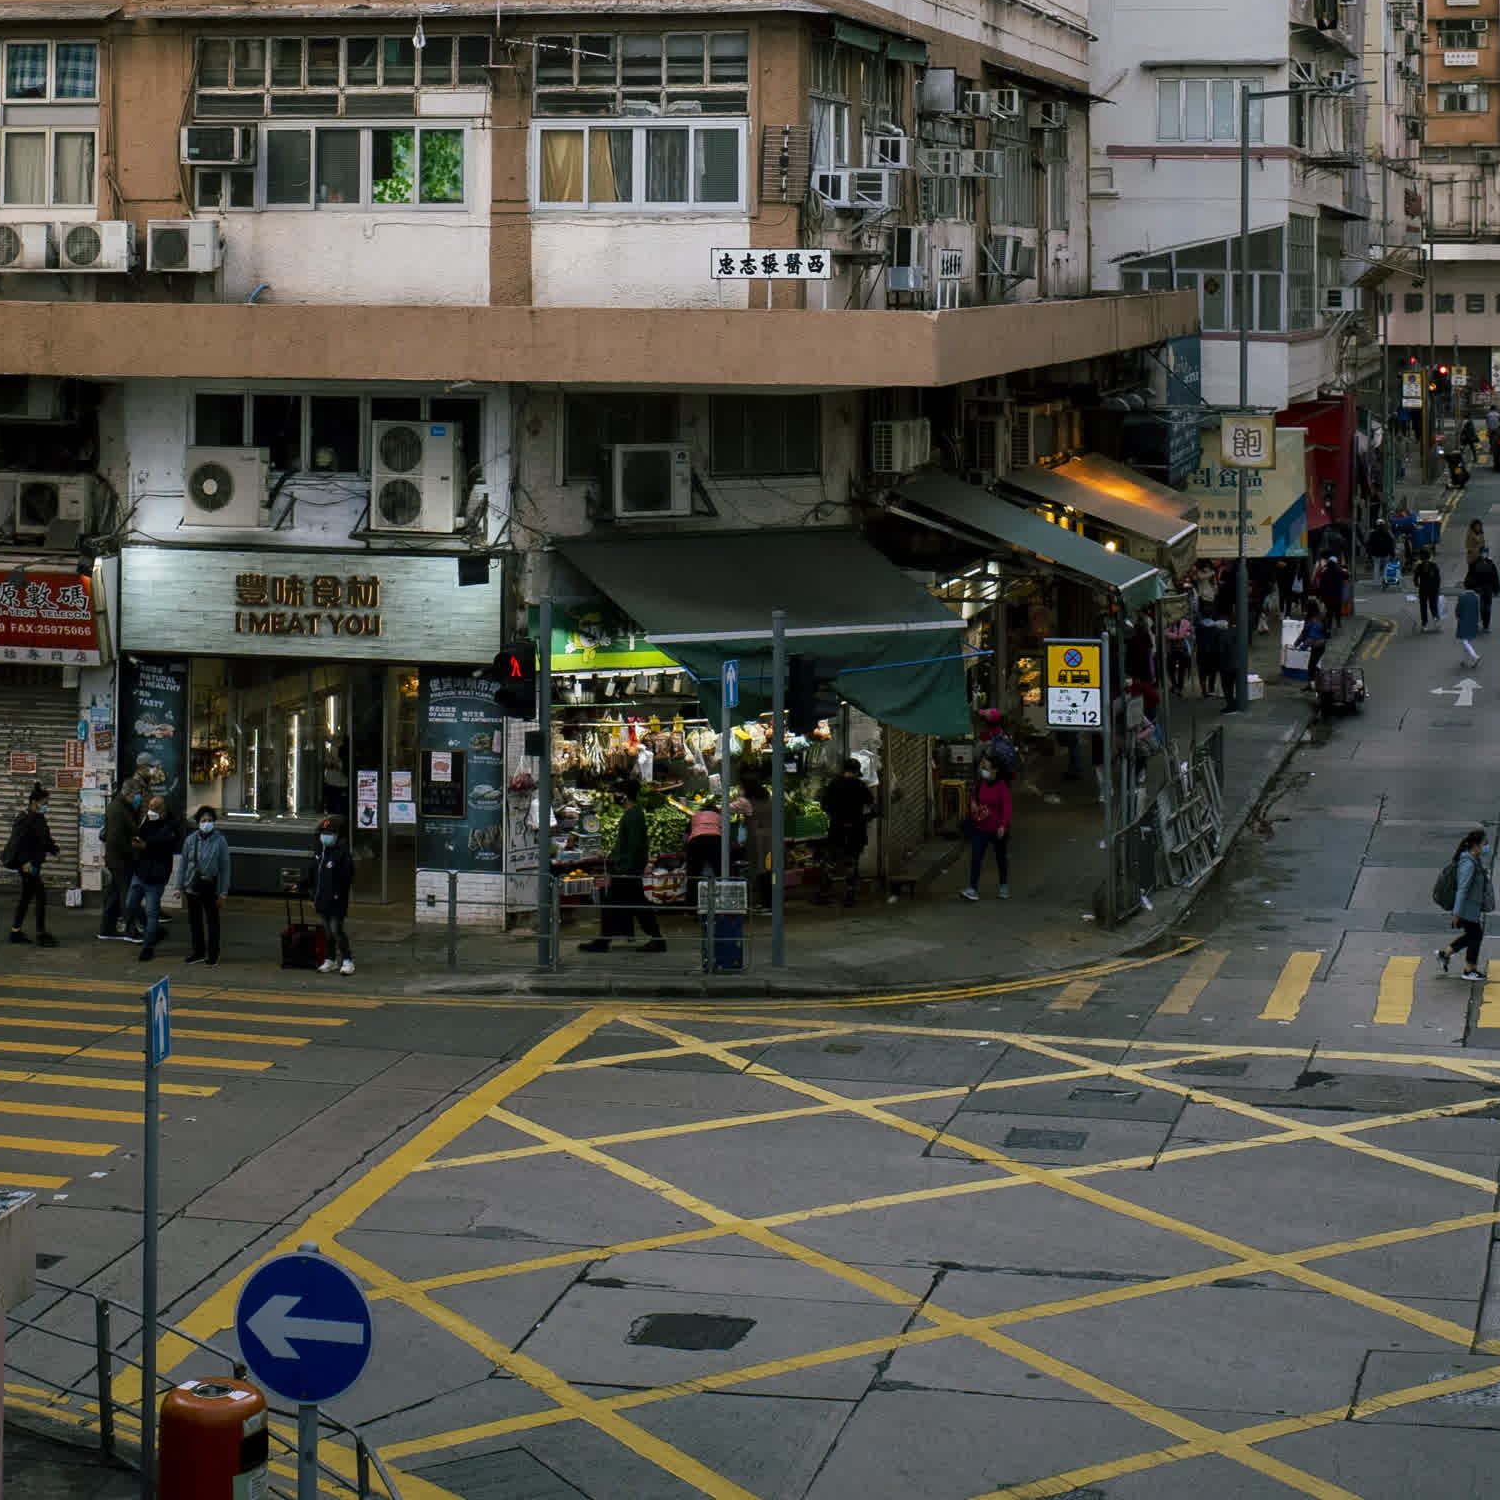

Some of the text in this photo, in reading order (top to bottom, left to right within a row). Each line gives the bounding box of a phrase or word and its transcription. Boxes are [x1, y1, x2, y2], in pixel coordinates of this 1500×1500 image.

[41, 610, 92, 620] TELECOM
[236, 612, 383, 636] I MEAT YOU
[1081, 690, 1090, 702] 7
[1082, 711, 1097, 723] 12
